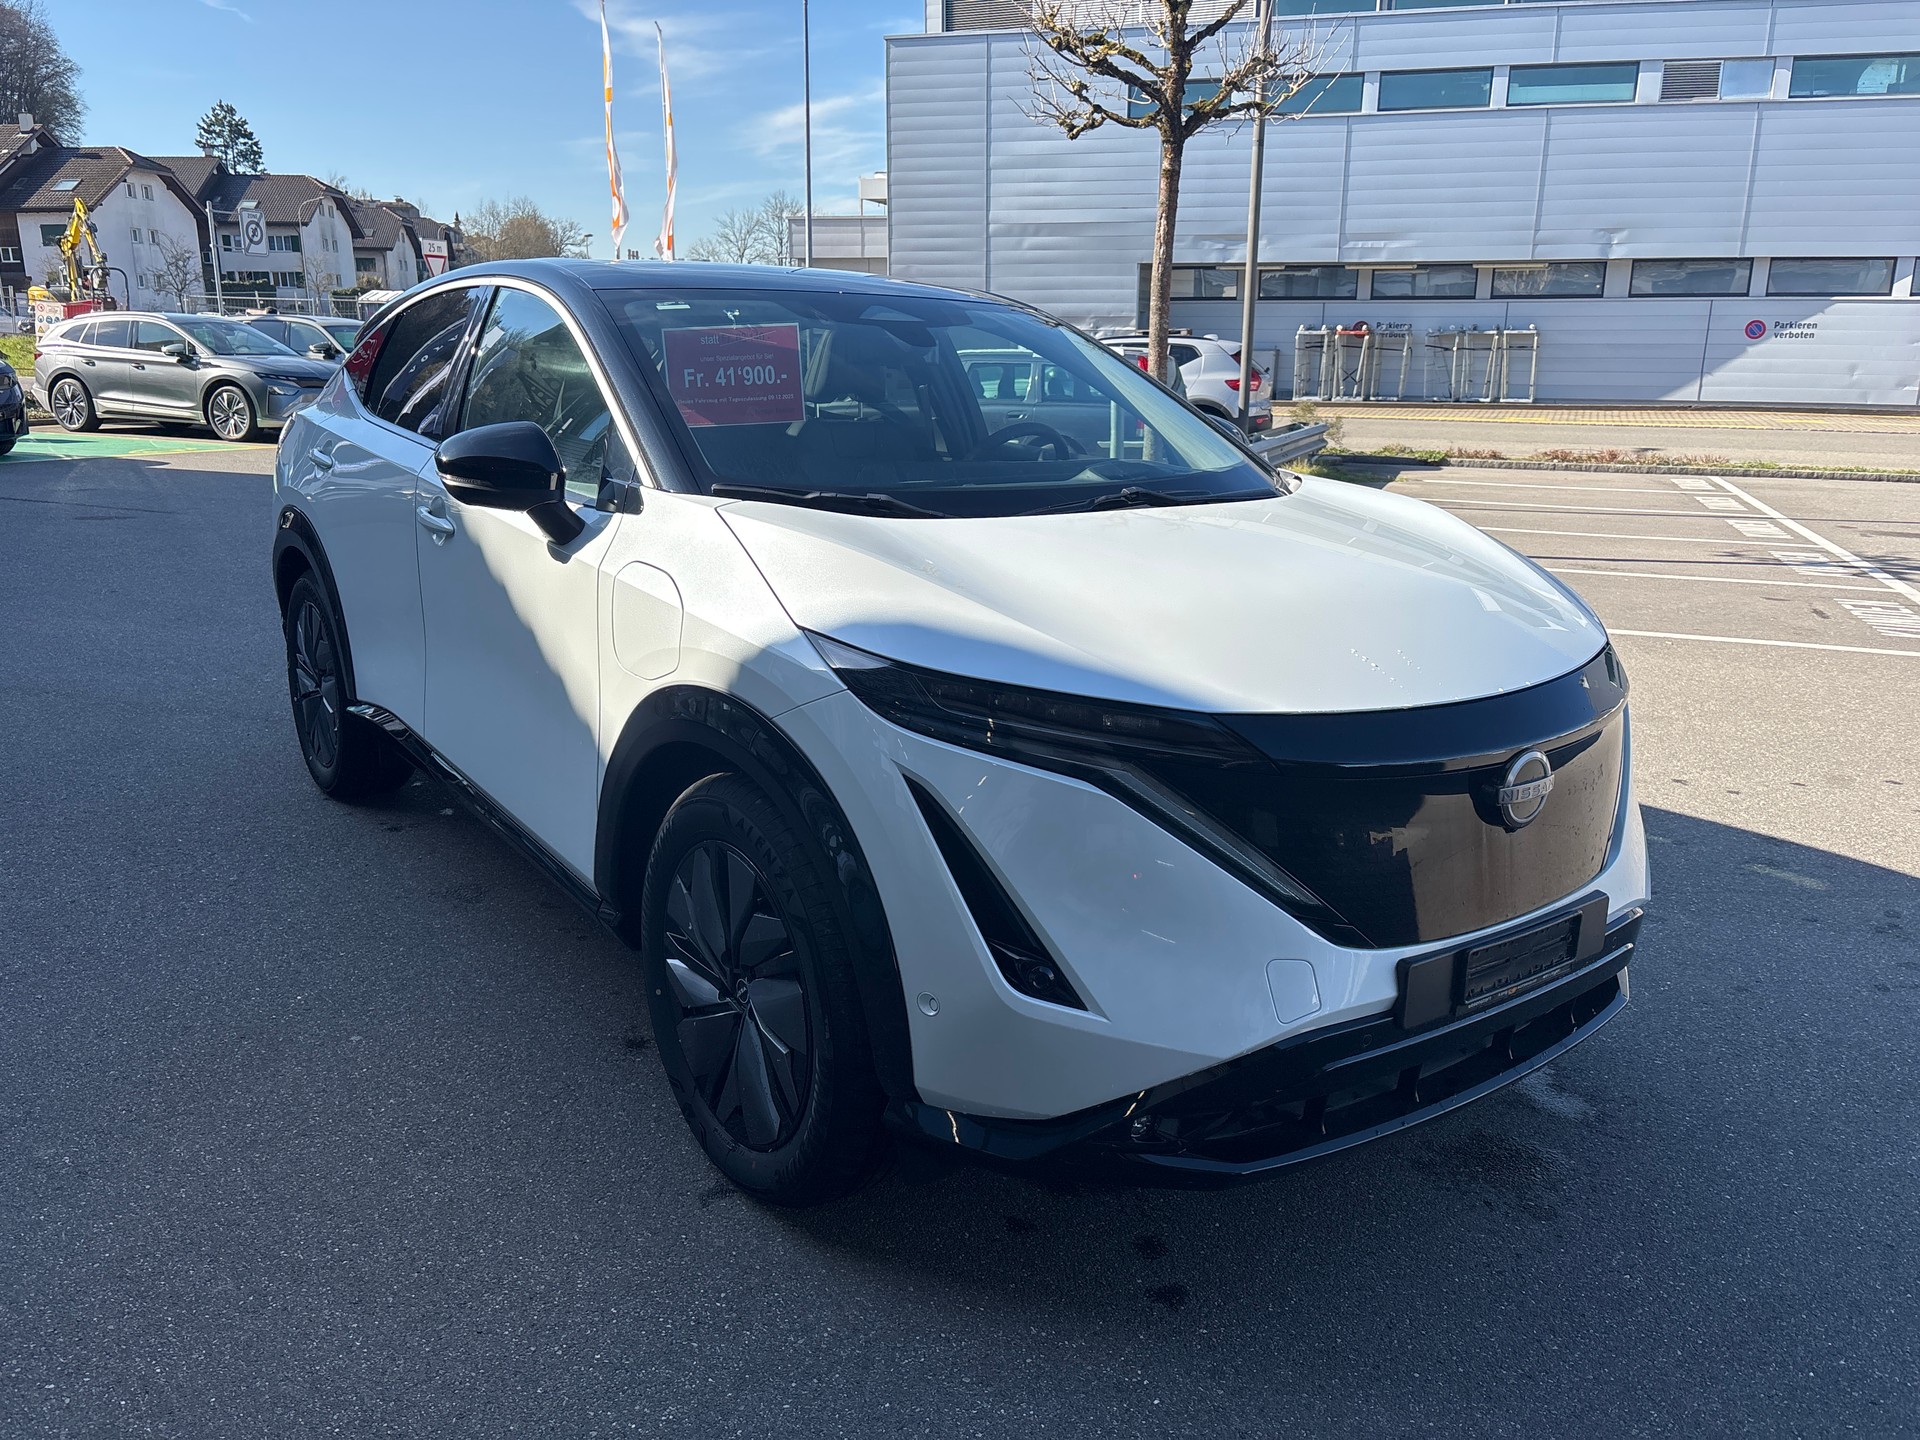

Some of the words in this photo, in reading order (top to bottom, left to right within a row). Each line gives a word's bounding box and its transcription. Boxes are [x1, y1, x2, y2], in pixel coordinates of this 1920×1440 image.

[428, 242, 436, 253] 25
[436, 245, 443, 253] m
[1774, 320, 1818, 330] Parkieren
[700, 334, 720, 345] statt
[1376, 331, 1413, 339] erbote
[1774, 331, 1815, 339] verboten
[716, 353, 755, 362] Spezialangebot
[683, 368, 709, 388] Fr.
[715, 365, 788, 387] 41'900.-
[728, 395, 767, 403] Tageszulassung
[1502, 779, 1554, 801] NISSAN
